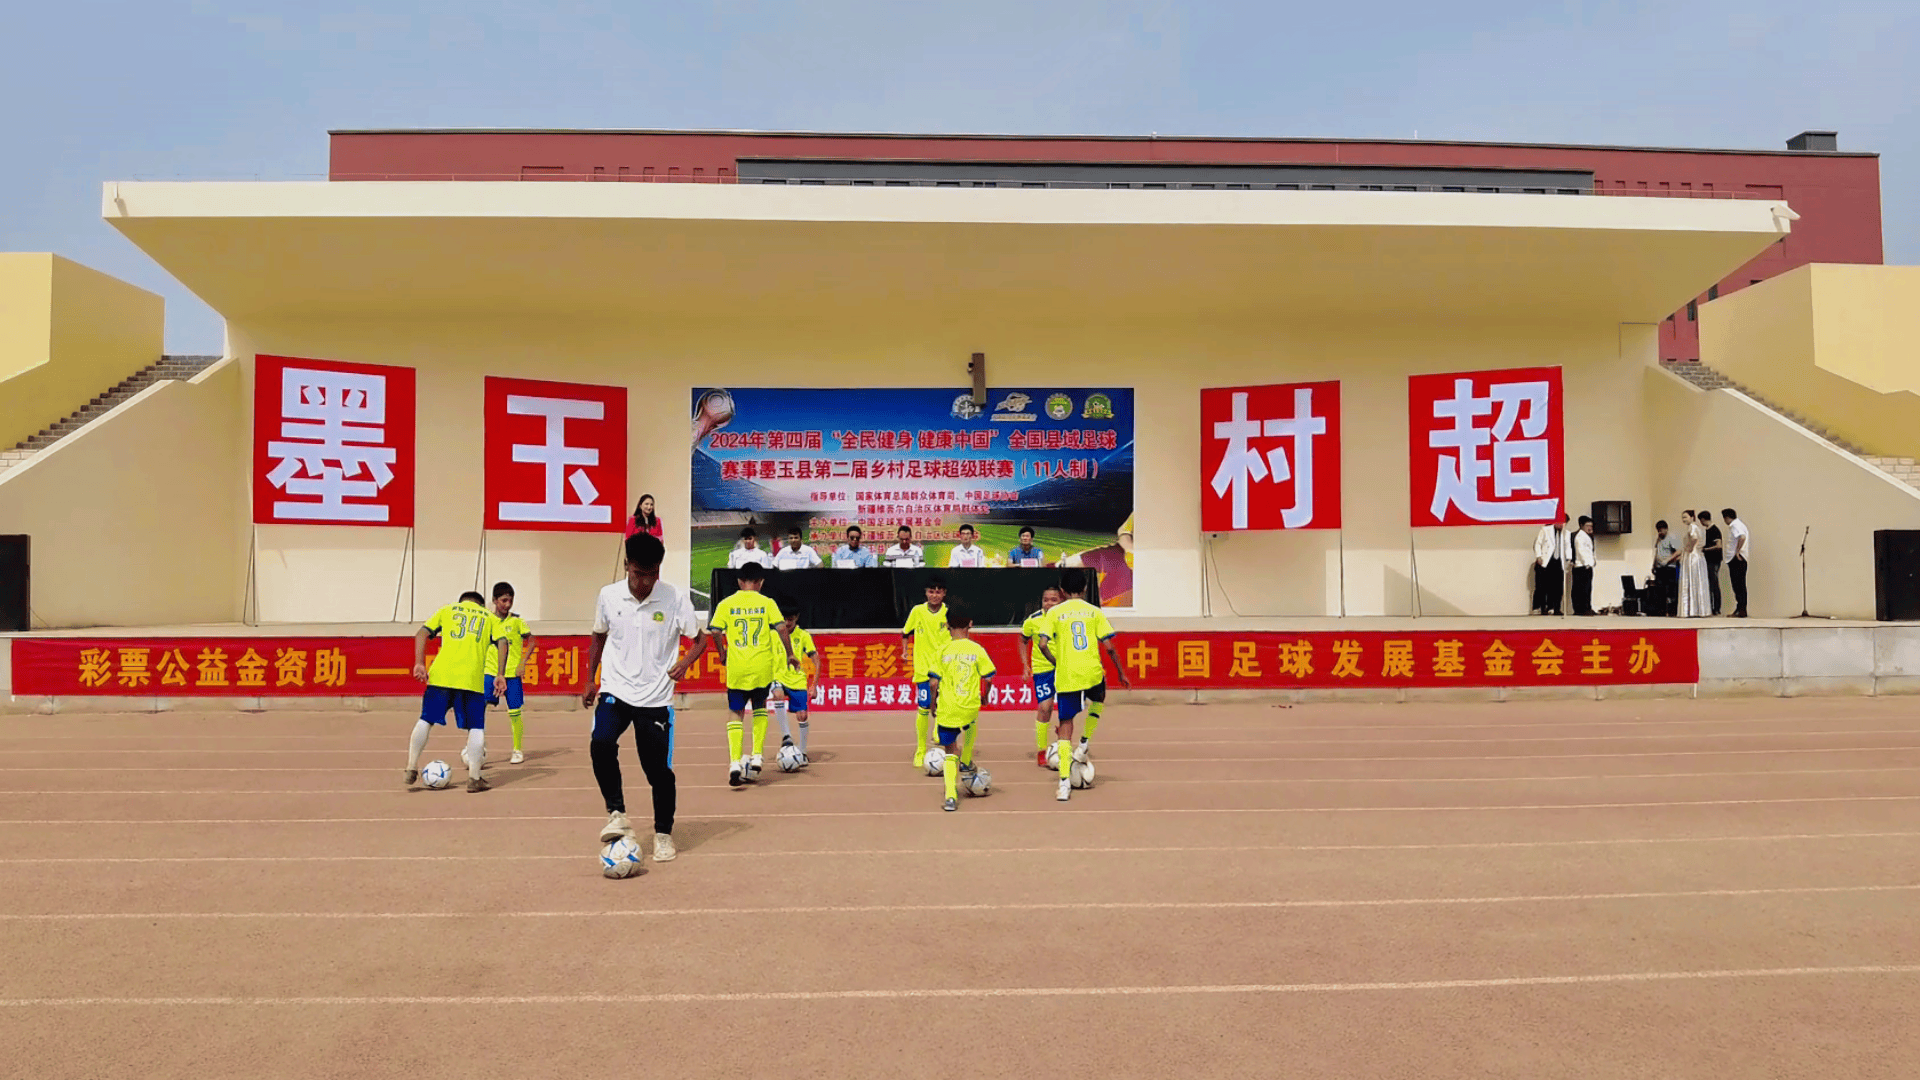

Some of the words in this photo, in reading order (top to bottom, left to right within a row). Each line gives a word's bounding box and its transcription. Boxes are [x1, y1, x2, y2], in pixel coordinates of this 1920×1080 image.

[265, 366, 397, 522] 墨
[498, 394, 612, 523] 玉
[1210, 388, 1326, 529] 村
[1428, 378, 1560, 522] 超
[450, 612, 486, 643] 34
[734, 617, 763, 647] 37
[1071, 620, 1088, 650] 8
[1126, 637, 1660, 678] 中国足球发展基金会主办
[1035, 683, 1052, 698] 55
